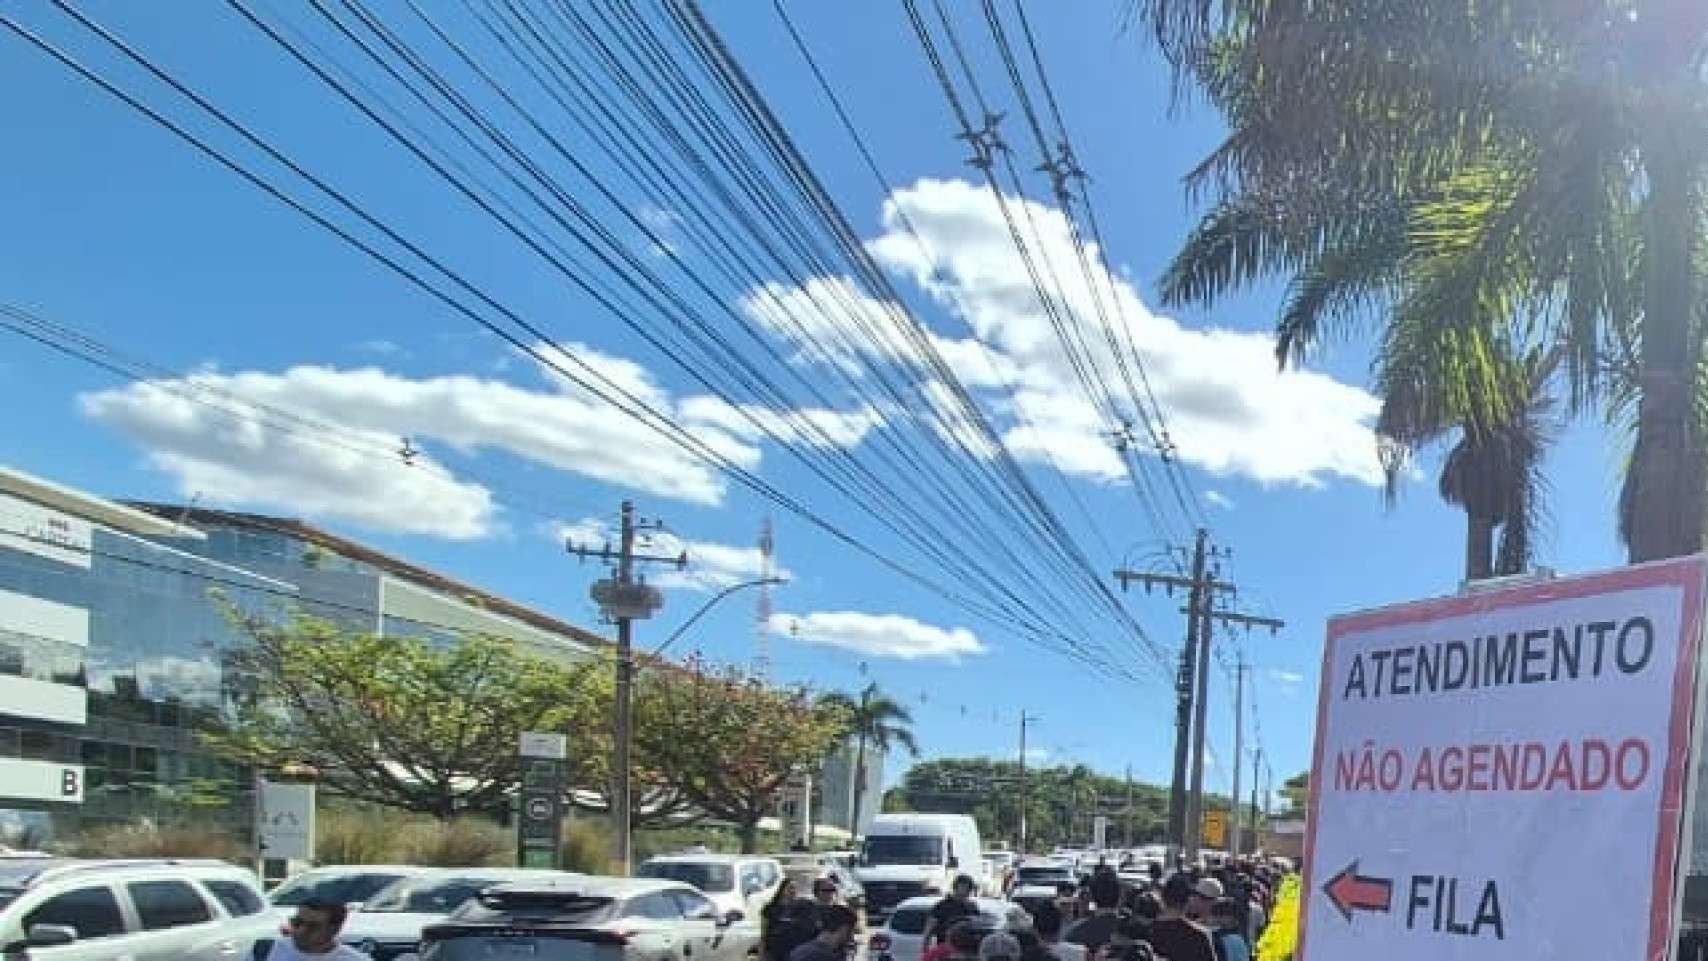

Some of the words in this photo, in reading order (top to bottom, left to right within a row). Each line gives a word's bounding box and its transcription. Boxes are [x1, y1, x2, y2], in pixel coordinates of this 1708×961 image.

[1345, 617, 1655, 699] ATENDIMENTO
[63, 769, 78, 796] B
[1335, 740, 1401, 791] NÃO
[1412, 740, 1650, 791] AGENDADO
[1407, 875, 1504, 940] FILA
